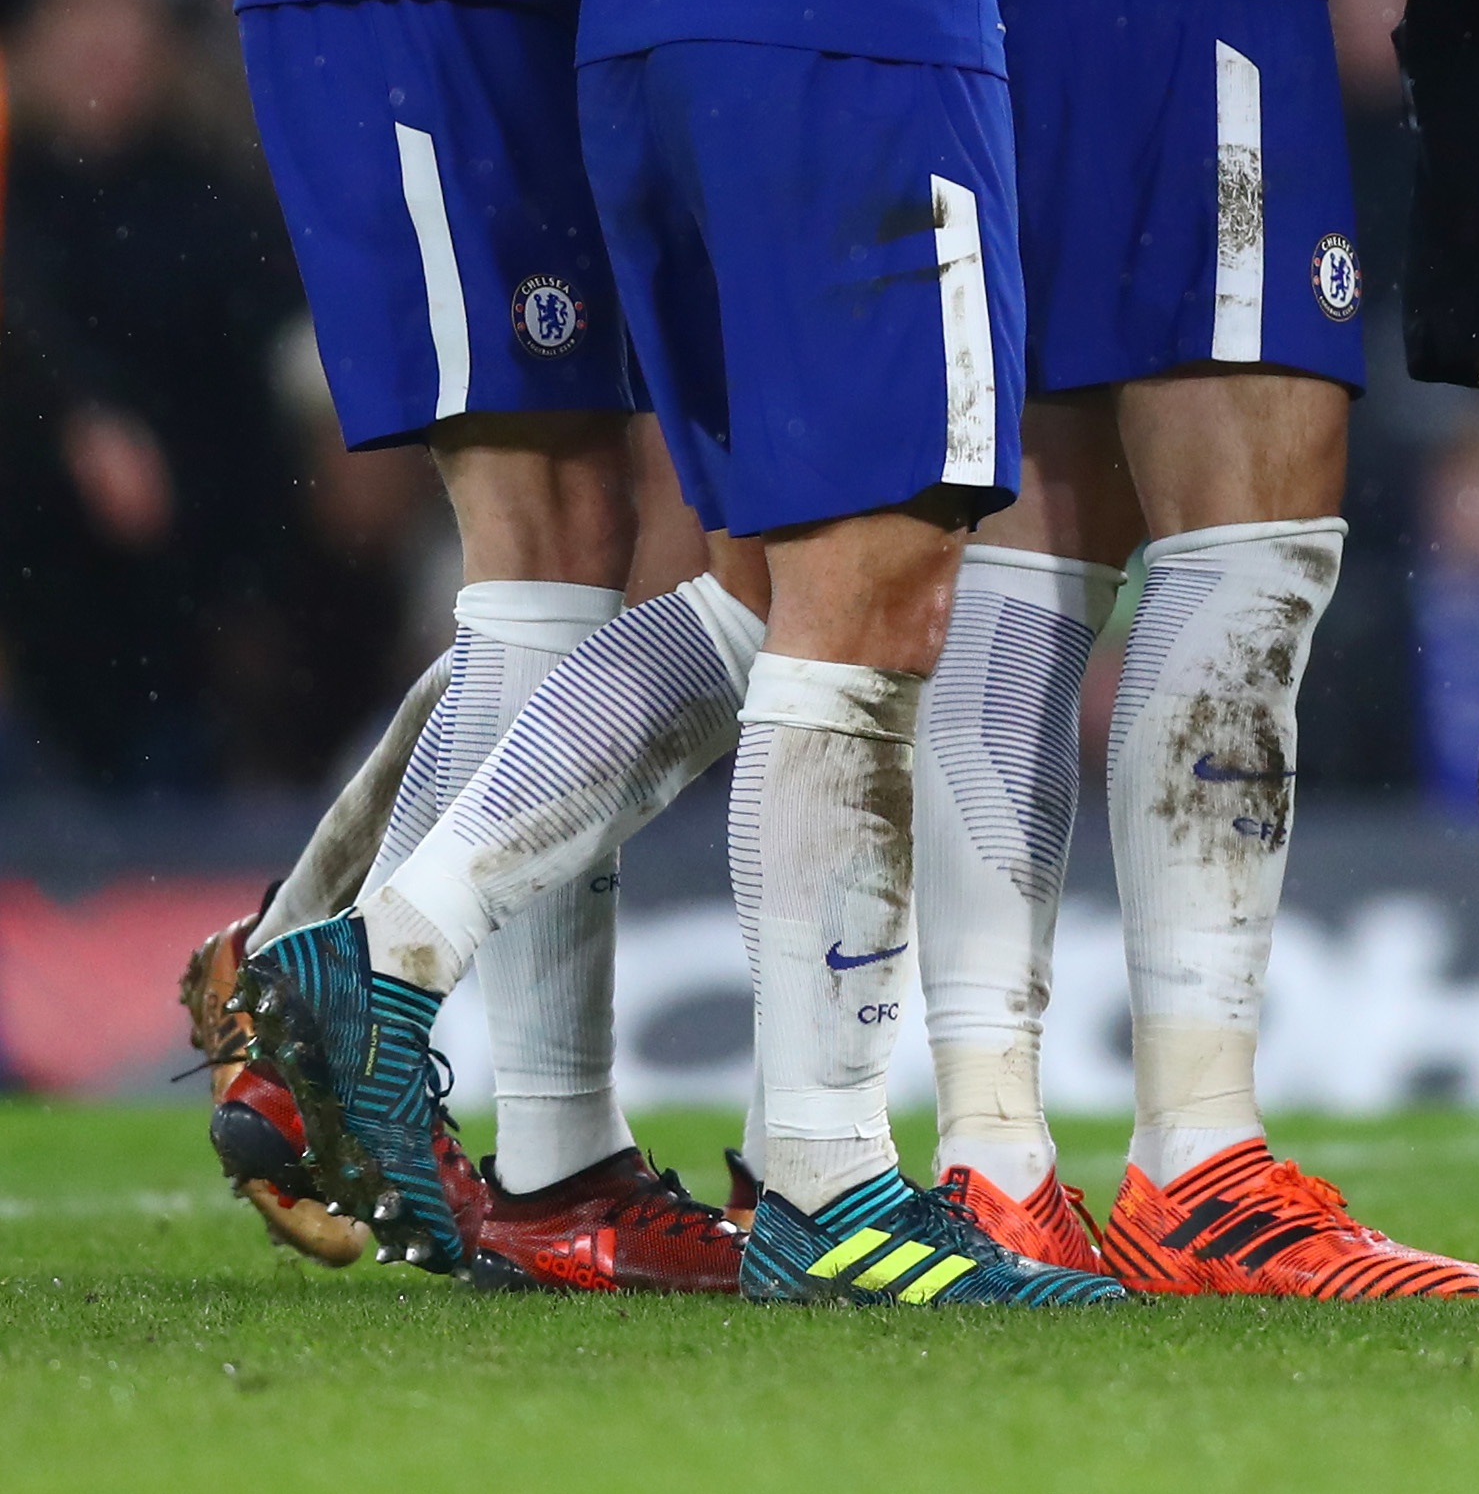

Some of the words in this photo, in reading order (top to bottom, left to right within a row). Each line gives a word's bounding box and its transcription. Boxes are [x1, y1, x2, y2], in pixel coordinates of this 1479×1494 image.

[1321, 236, 1354, 259] CHELSEA
[521, 277, 570, 295] CHELSEA
[858, 1003, 899, 1024] CFC
